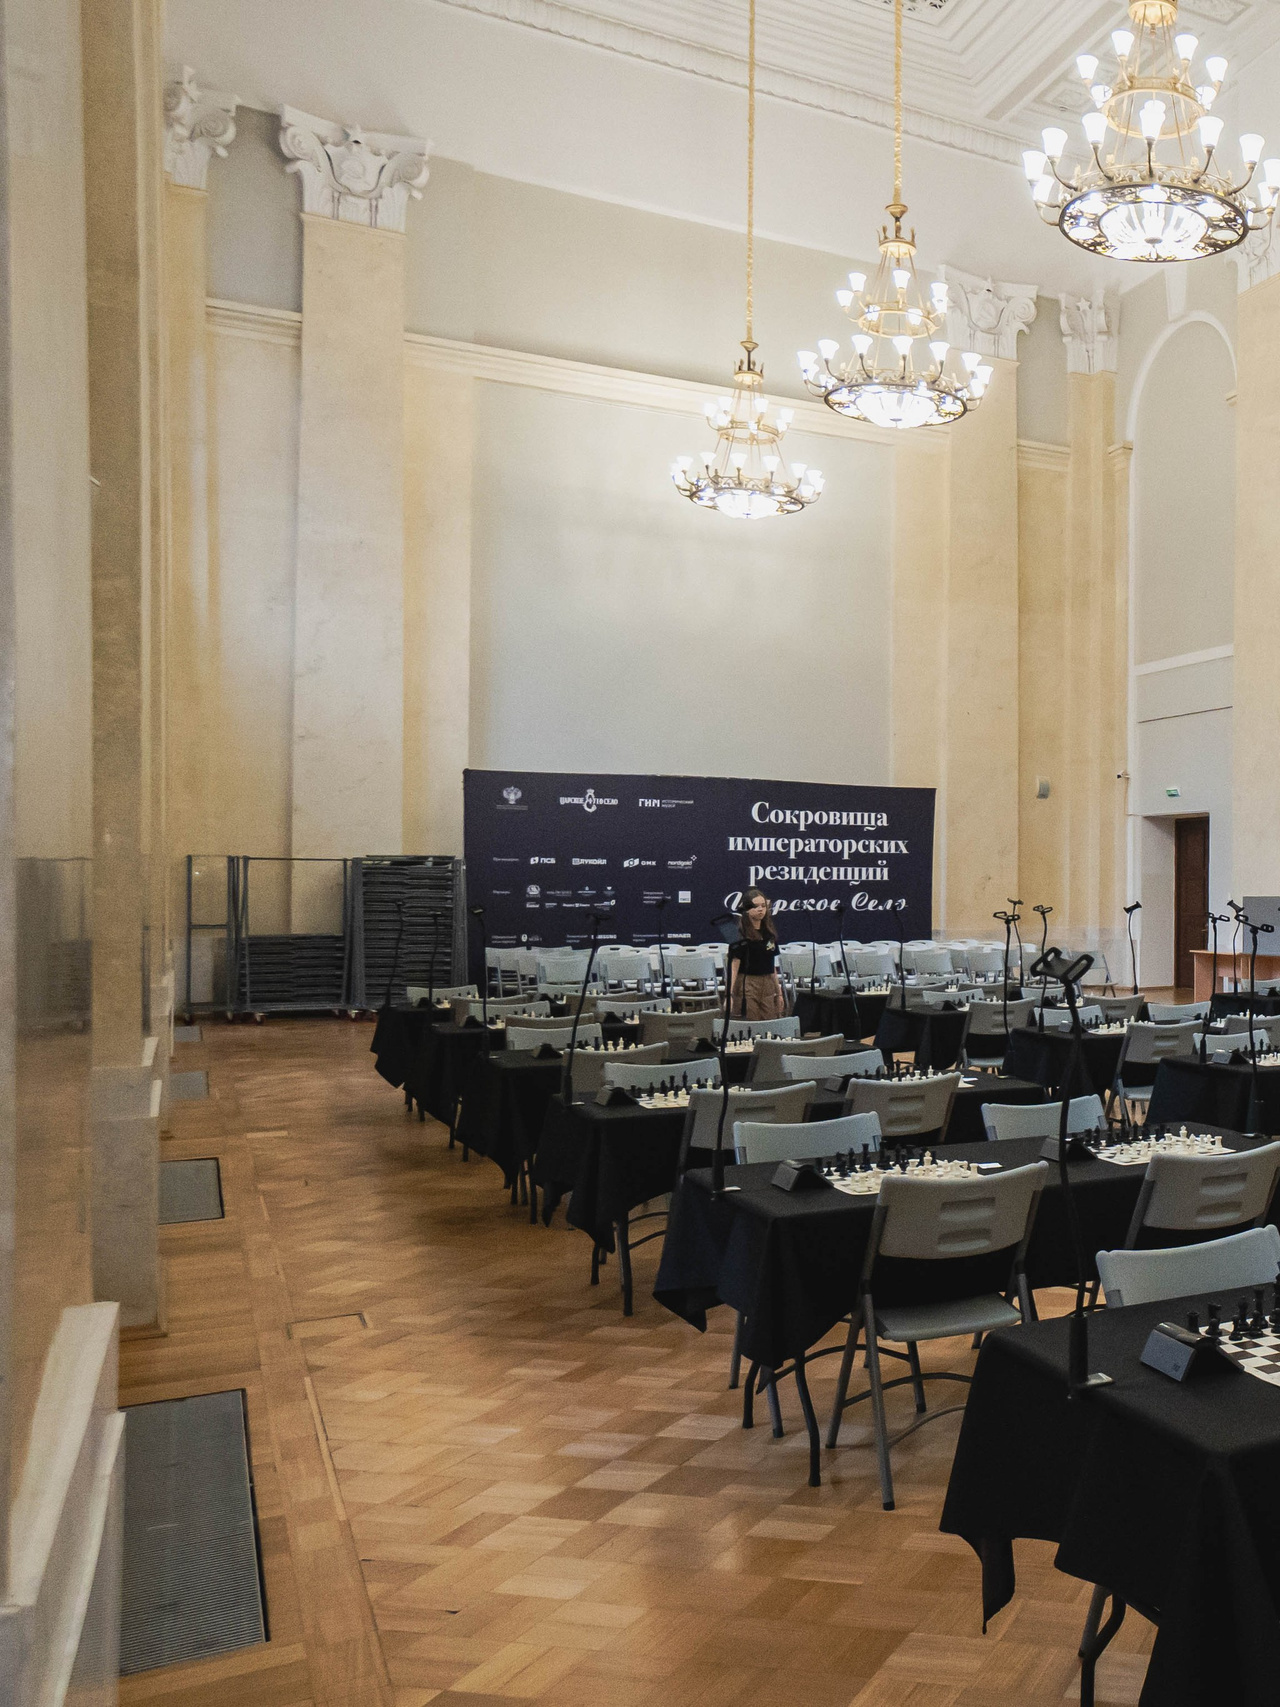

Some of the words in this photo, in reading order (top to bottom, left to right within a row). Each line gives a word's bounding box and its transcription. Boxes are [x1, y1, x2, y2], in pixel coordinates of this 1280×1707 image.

[638, 798, 661, 808] ГИМ
[751, 801, 889, 832] Сокровища
[727, 836, 910, 860] императорских
[748, 859, 890, 887] резиденций
[851, 891, 908, 912] Село
